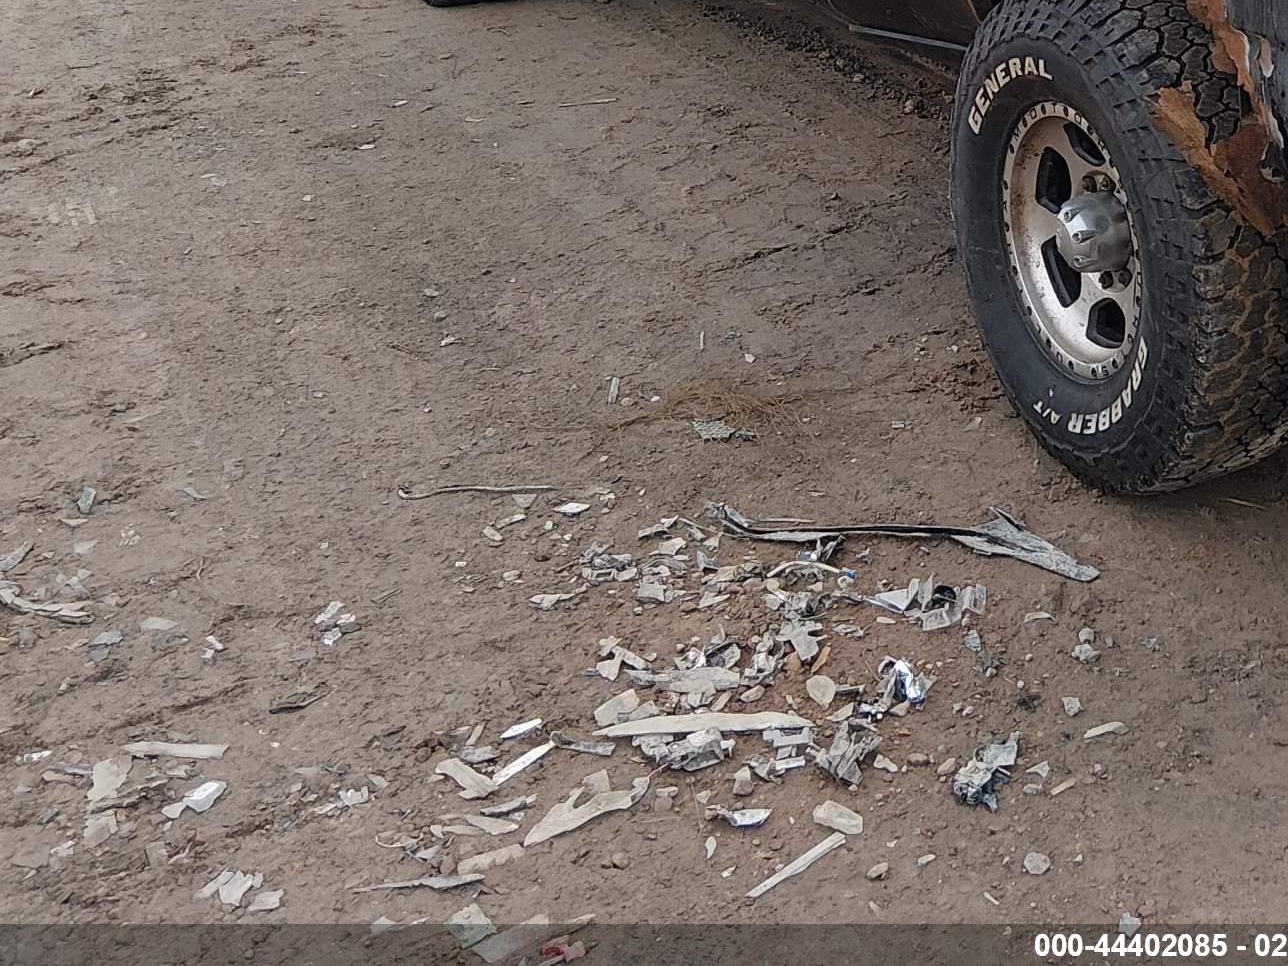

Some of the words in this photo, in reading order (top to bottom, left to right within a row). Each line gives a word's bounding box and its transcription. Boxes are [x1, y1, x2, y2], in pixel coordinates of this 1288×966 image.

[967, 56, 1053, 135] GENERAL
[1032, 399, 1062, 425] A/T
[1066, 335, 1149, 436] GRABBER
